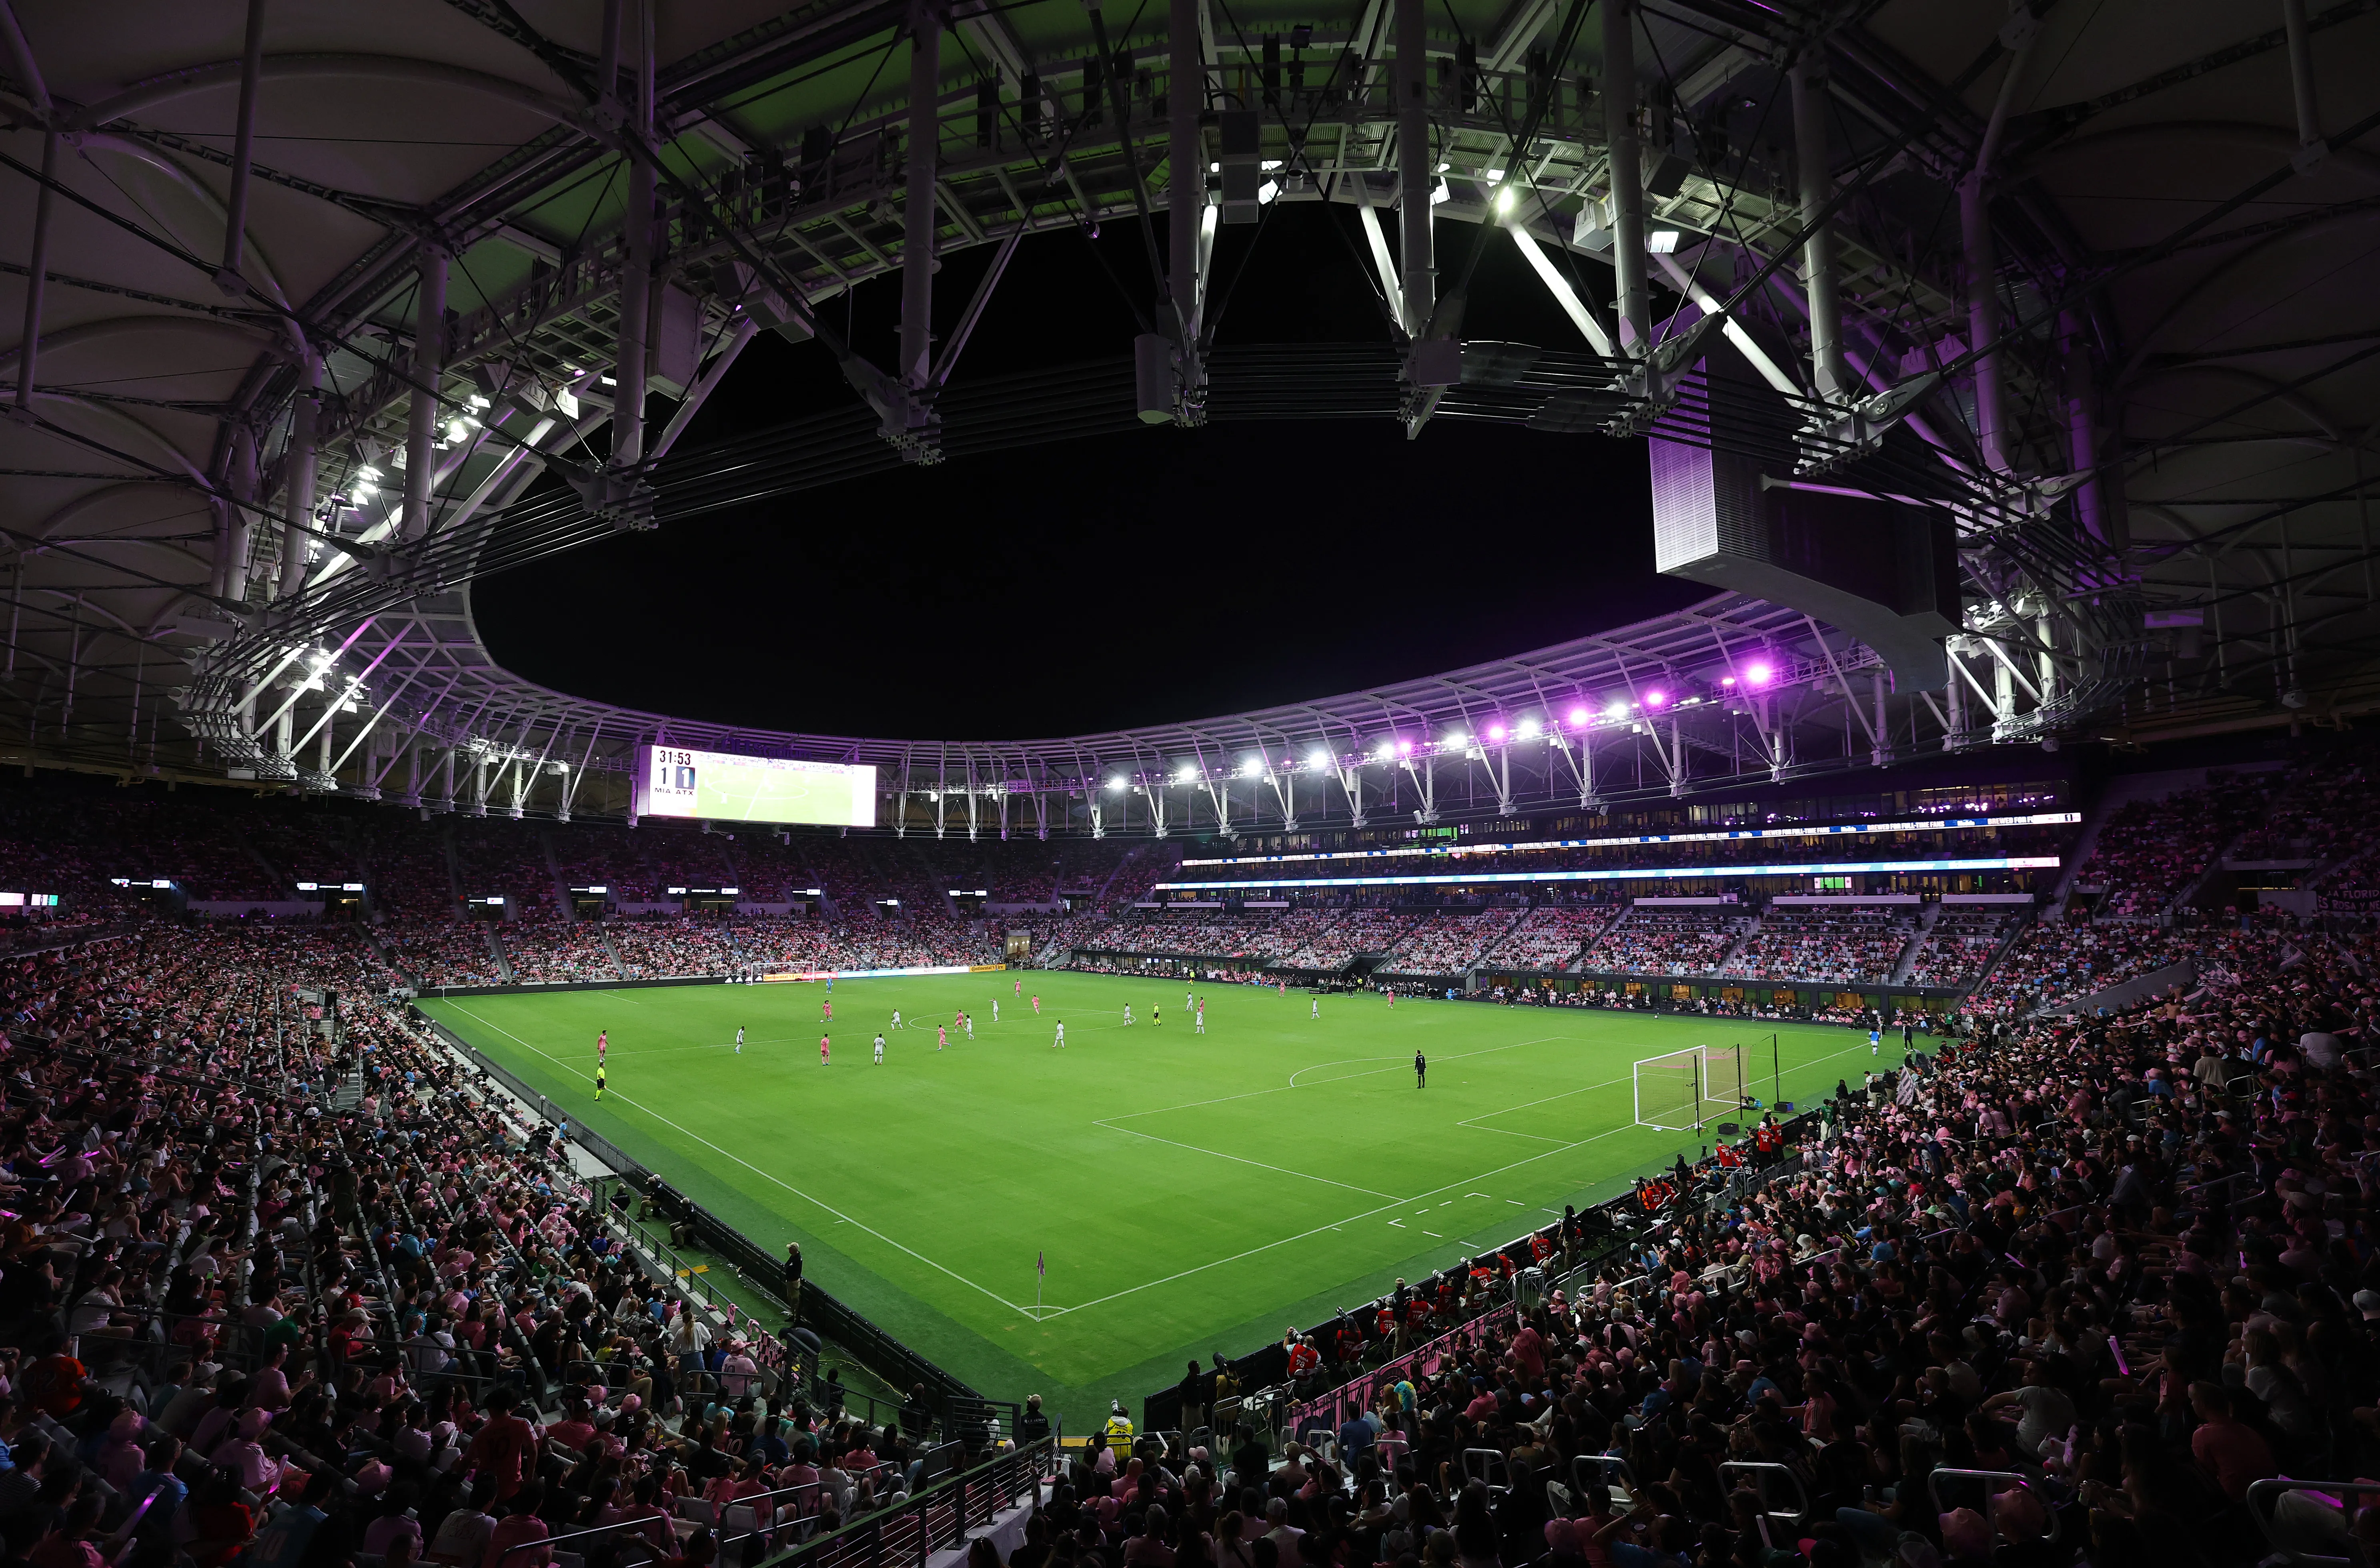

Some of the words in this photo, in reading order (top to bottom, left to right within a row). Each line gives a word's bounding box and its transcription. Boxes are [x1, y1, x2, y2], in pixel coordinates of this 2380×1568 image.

[660, 750, 691, 765] 31:53
[661, 767, 666, 784] 1
[681, 768, 690, 788] 1
[2332, 900, 2356, 910] ROSA
[2360, 902, 2365, 910] Y
[1296, 1354, 1308, 1363] MEDIA
[1296, 1359, 1304, 1368] 98
[1492, 1356, 1506, 1367] 10
[725, 1364, 735, 1376] 10
[726, 1438, 743, 1455] 10
